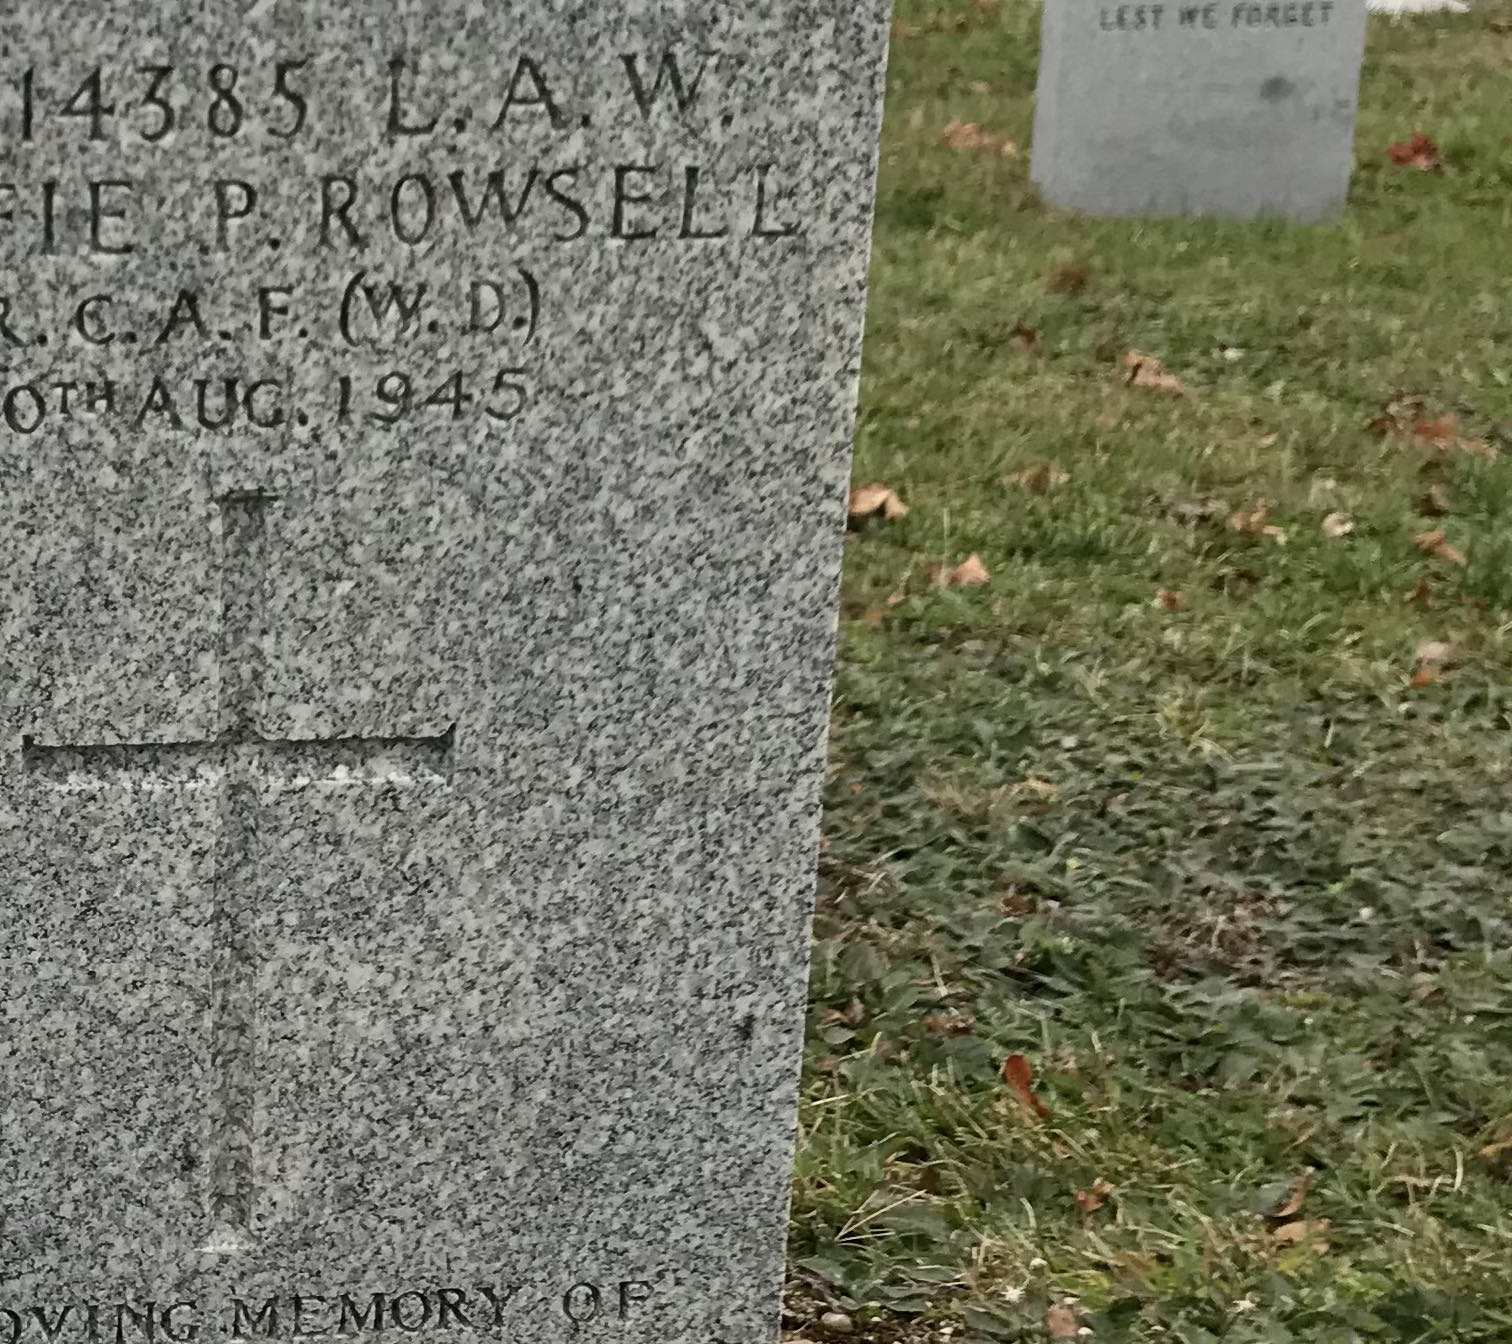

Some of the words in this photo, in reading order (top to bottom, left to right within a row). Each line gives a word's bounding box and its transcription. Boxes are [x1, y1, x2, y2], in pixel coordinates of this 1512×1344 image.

[1098, 5, 1164, 31] LEST
[1178, 3, 1220, 30] WE
[1229, 1, 1334, 29] FORGET
[231, 1286, 519, 1338] MEMORY
[562, 1280, 654, 1326] OF
